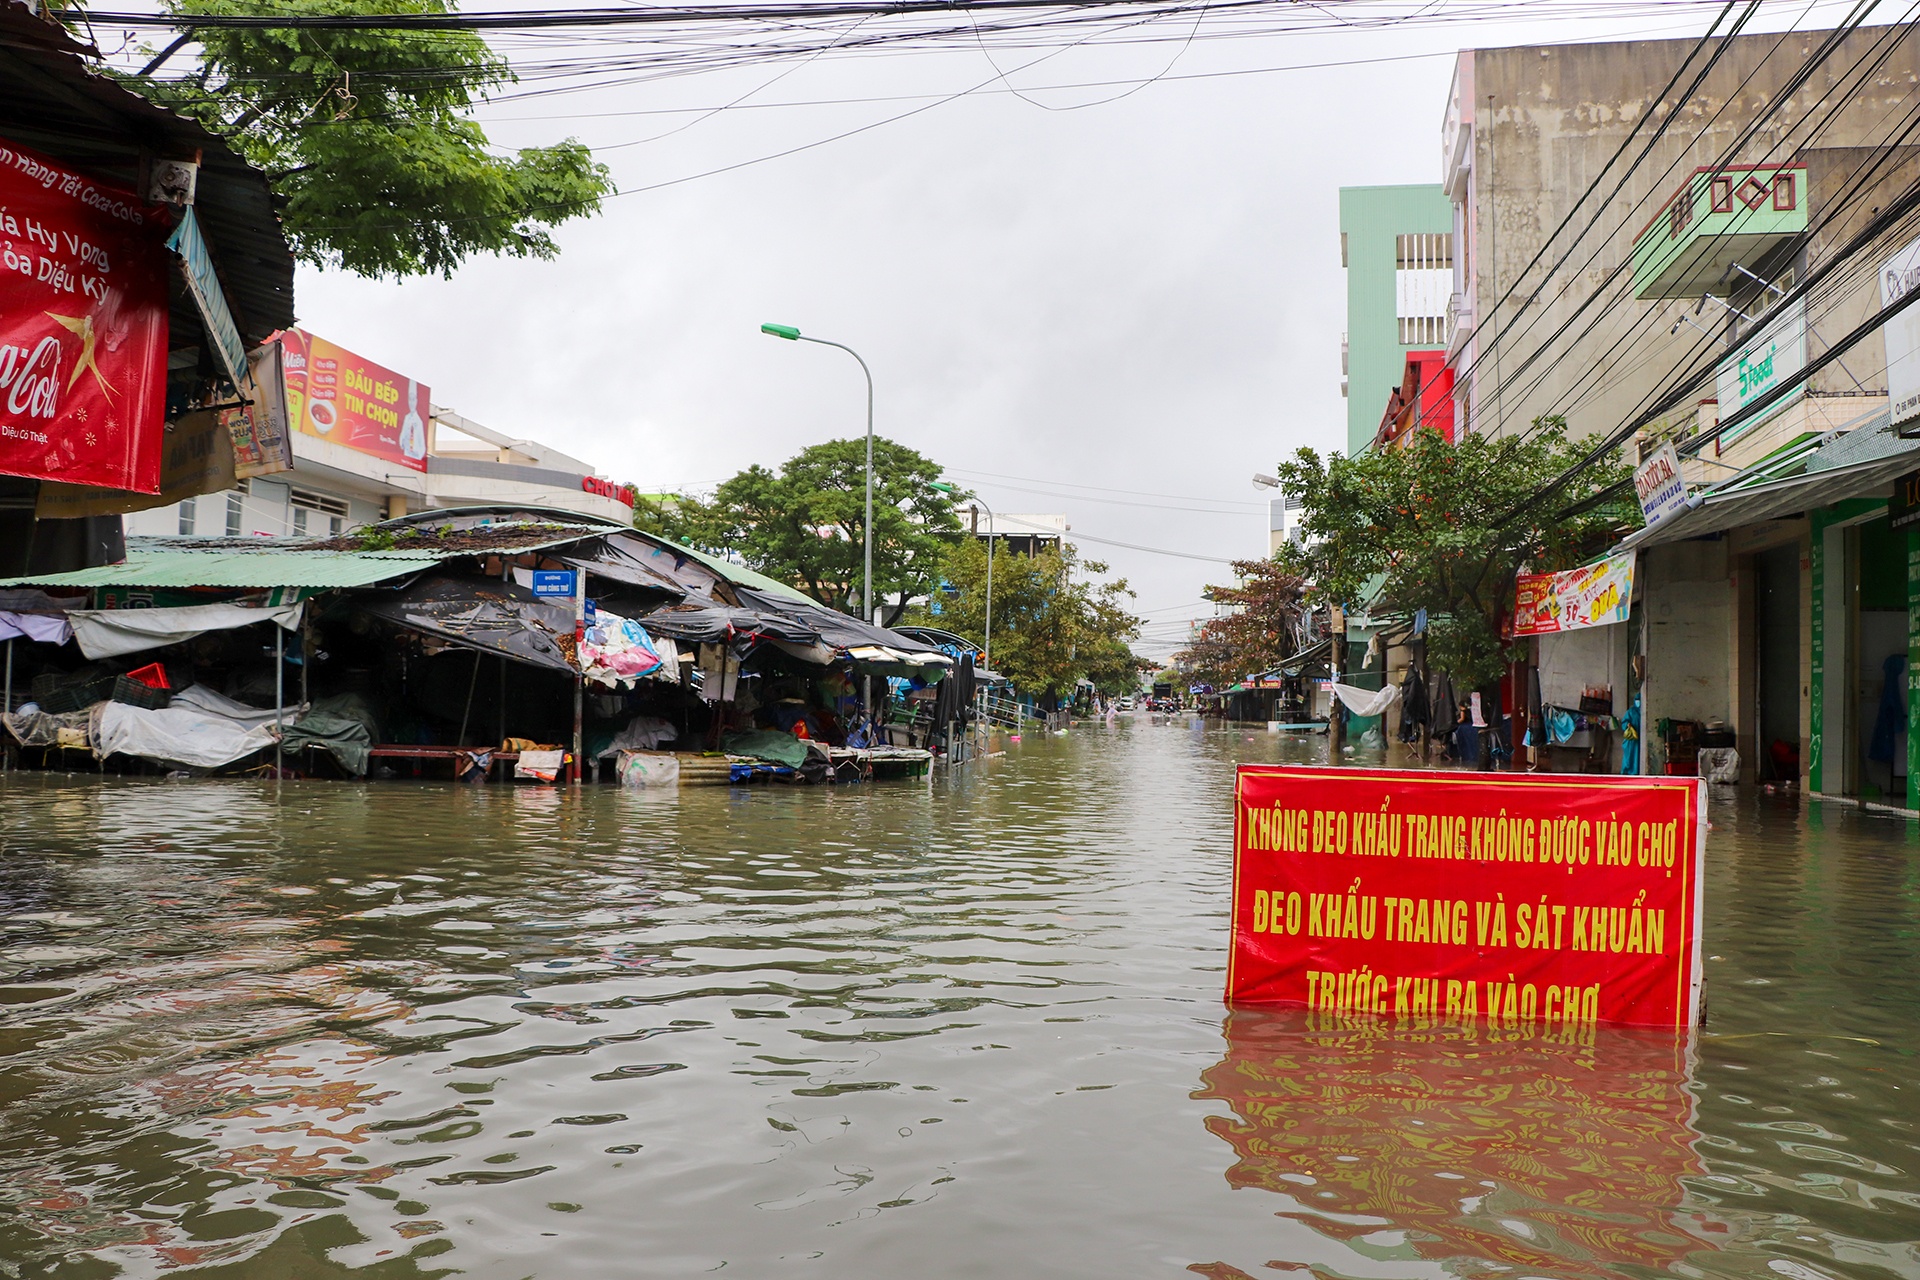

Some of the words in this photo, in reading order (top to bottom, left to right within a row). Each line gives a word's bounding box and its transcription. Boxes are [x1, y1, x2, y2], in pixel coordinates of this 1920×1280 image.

[15, 152, 58, 188] Hàng
[58, 172, 82, 197] Tết
[26, 217, 57, 253] Hy
[63, 231, 110, 273] Vọng
[37, 256, 74, 294] Diệu
[82, 273, 110, 305] Kỳ
[345, 367, 372, 395] ĐẦU
[375, 380, 399, 405] BẾP
[344, 393, 364, 415] TIN
[366, 402, 398, 429] CHỌN
[582, 476, 614, 502] CHỢ
[1590, 581, 1620, 623] QUÀ
[1247, 800, 1308, 852] KHÔNG
[1312, 810, 1348, 855] ĐEO
[1352, 795, 1401, 857] KHẨU
[1406, 814, 1466, 860] TRANG
[1471, 808, 1535, 862] KHÔNG
[1539, 815, 1590, 874] ĐƯỢC
[1596, 811, 1632, 867] VÀO
[1637, 818, 1677, 878] CHỢ
[1253, 889, 1302, 935] ĐEO
[1309, 876, 1377, 940] KHẨU
[1384, 897, 1468, 945] TRANG
[1475, 892, 1507, 947] VÀ
[1515, 895, 1566, 950] SÁT
[1572, 888, 1665, 955] KHUẨN
[1306, 965, 1388, 1014] TRƯỚC
[1395, 976, 1439, 1013] KHI
[1446, 979, 1478, 1016] RA
[1487, 973, 1537, 1019] VÀO
